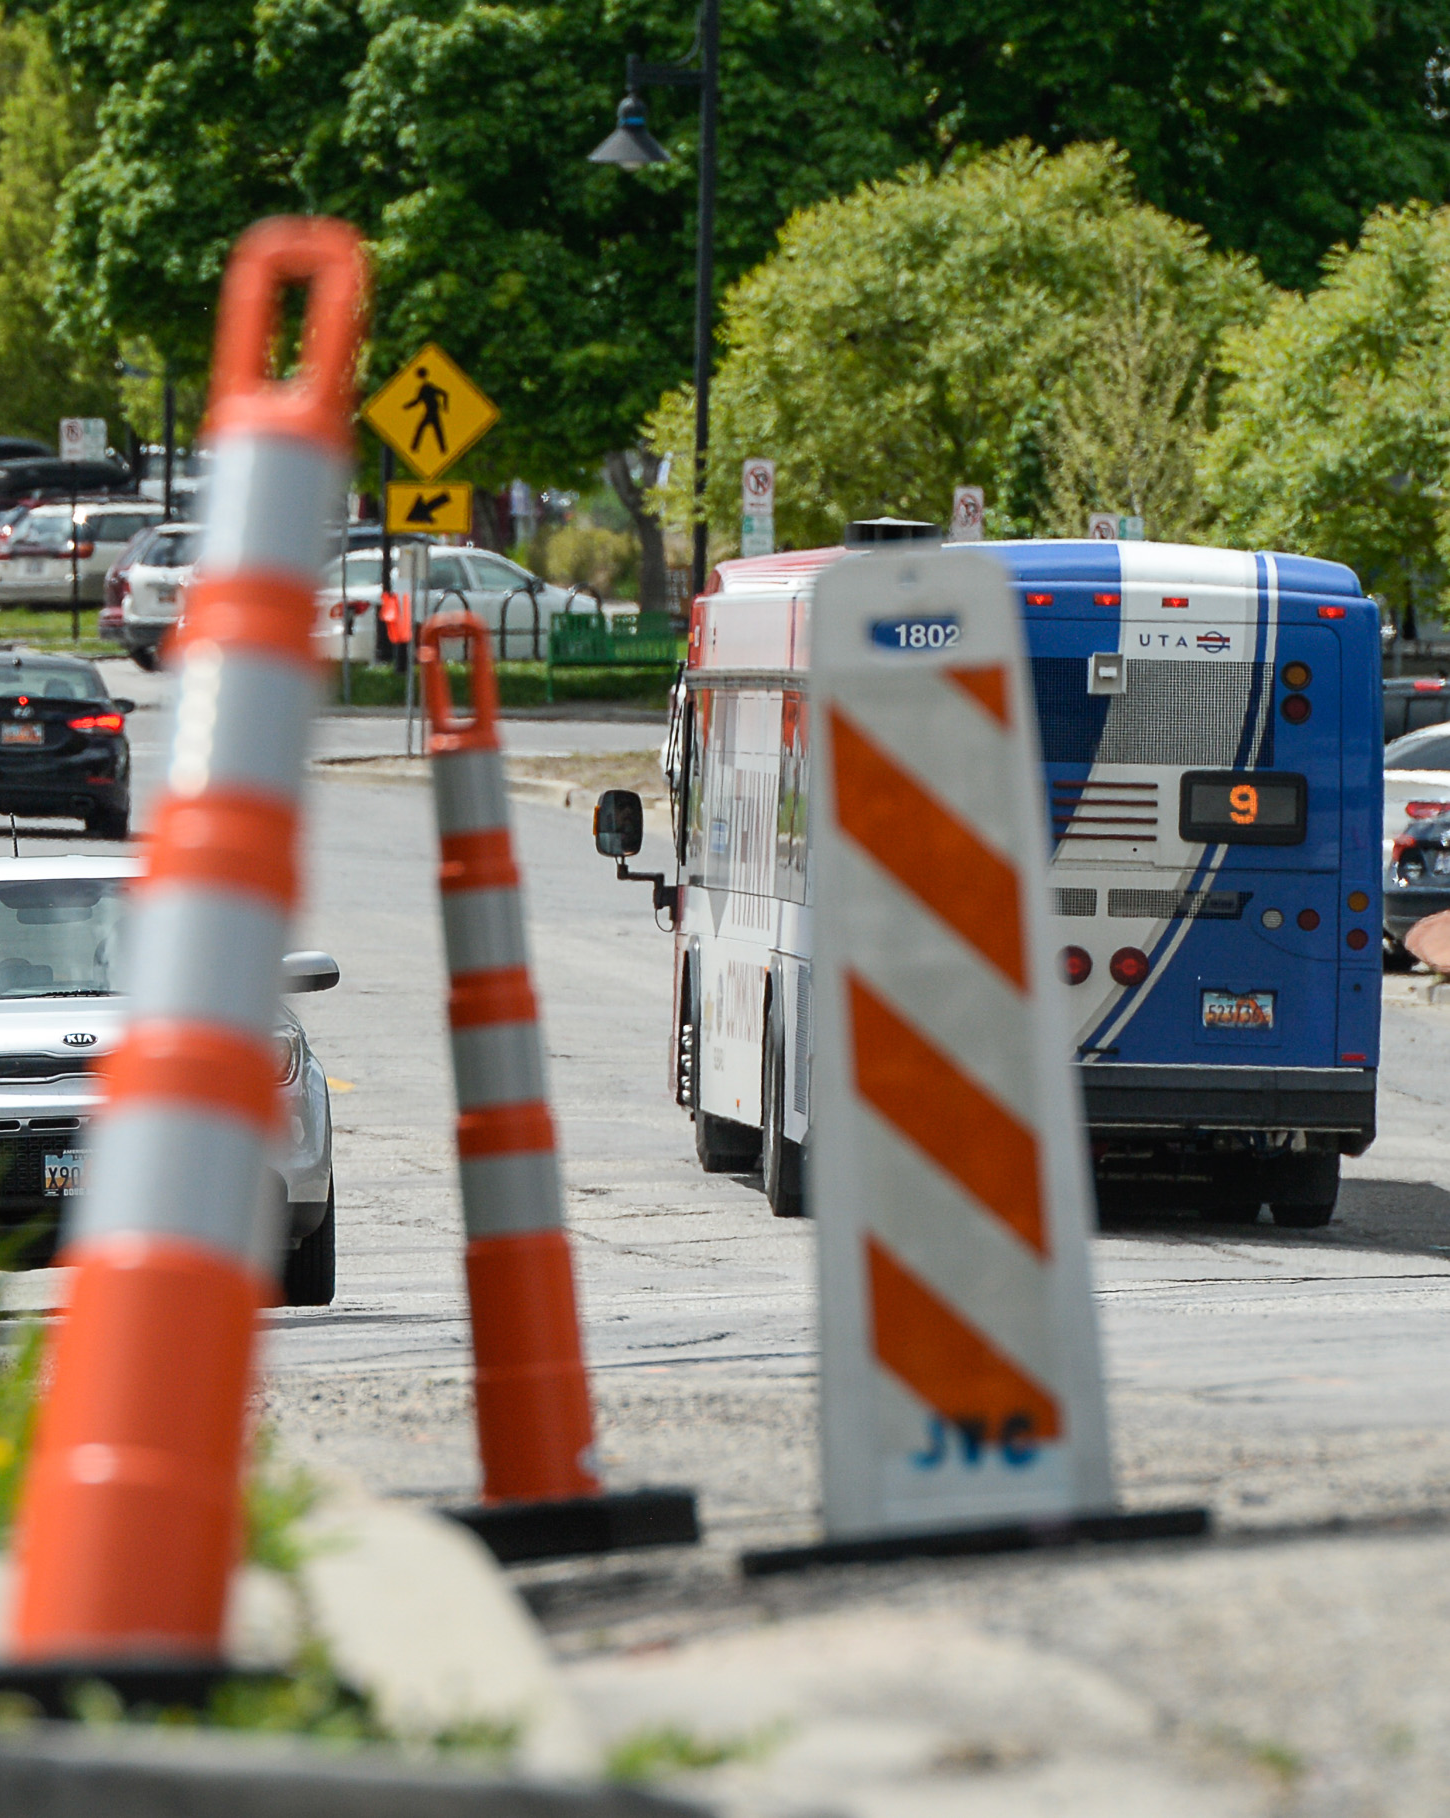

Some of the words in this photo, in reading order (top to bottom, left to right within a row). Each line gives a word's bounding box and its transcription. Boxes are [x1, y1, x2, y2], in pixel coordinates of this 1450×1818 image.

[894, 624, 960, 647] 1802
[1139, 634, 1188, 647] UTA
[1230, 784, 1258, 824] 9
[66, 1034, 93, 1043] KIA
